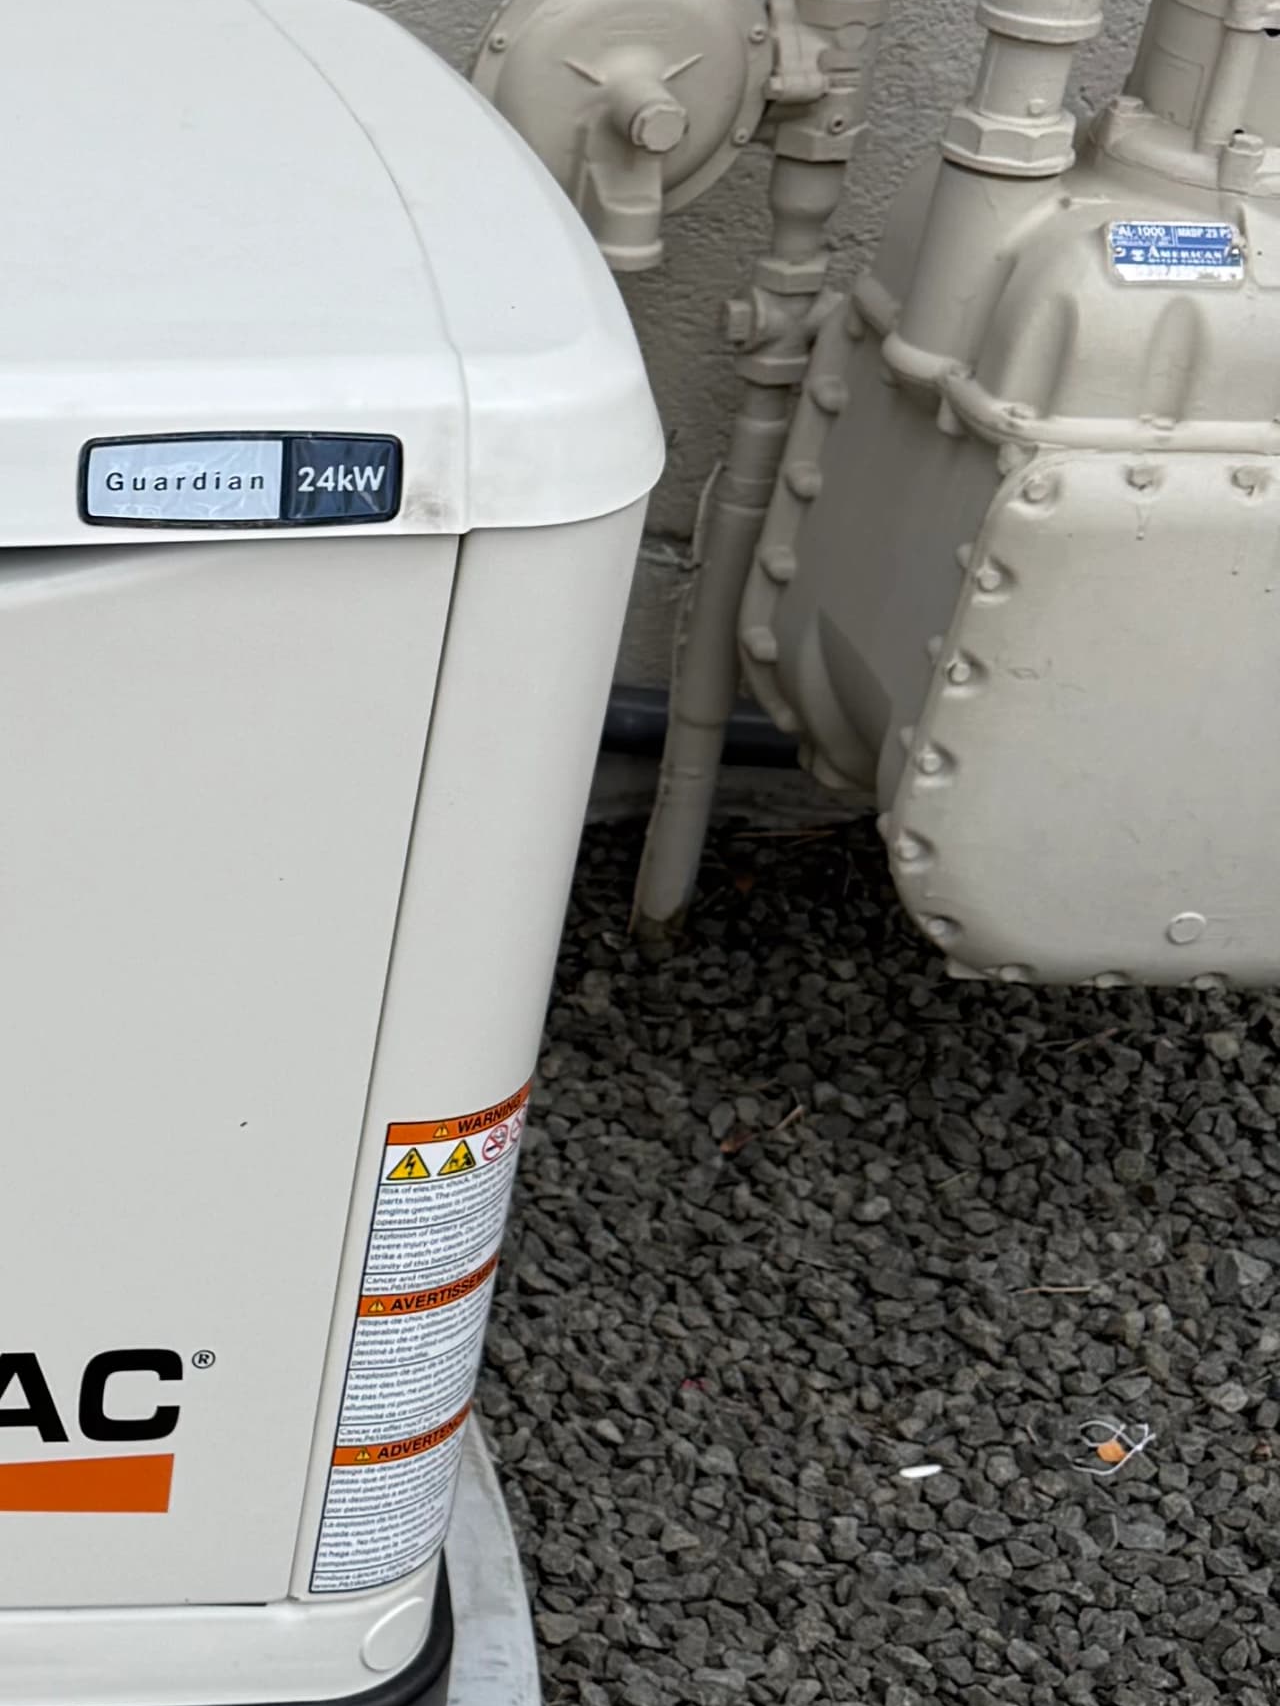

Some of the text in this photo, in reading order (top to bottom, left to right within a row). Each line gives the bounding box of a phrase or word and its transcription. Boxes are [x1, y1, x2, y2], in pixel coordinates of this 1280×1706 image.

[1148, 244, 1223, 260] AMERICAN
[105, 465, 386, 493] Guardian 24kW
[457, 1093, 521, 1134] WARNING
